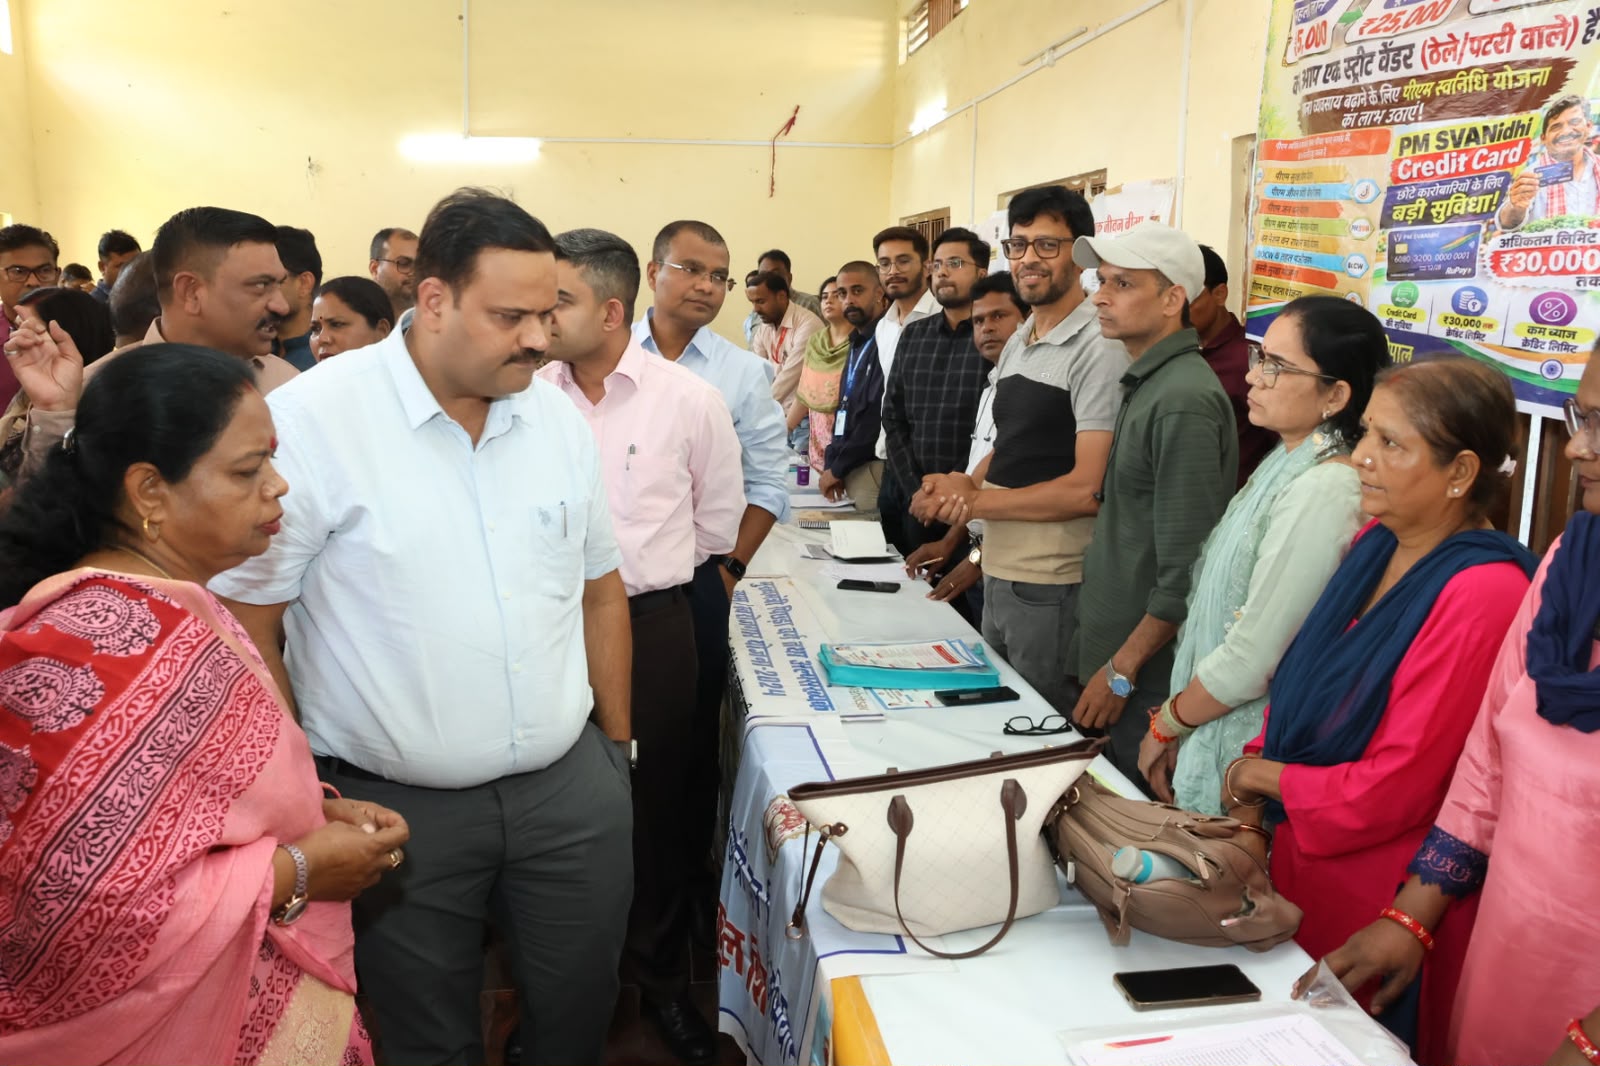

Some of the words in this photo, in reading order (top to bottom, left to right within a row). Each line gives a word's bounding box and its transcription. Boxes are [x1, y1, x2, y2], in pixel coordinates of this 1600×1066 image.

[1344, 46, 1376, 82] स्ट्रीट
[1520, 14, 1580, 51] वाले)
[1368, 86, 1378, 106] के
[1378, 83, 1401, 105] लिए
[1402, 79, 1434, 101] पीएम
[1435, 68, 1489, 97] स्वनिधि
[1493, 65, 1552, 91] योजना
[1341, 112, 1359, 129] का
[1357, 111, 1385, 127] लाभ
[1385, 101, 1424, 124] उठाएं!
[1399, 133, 1430, 156] PM
[1434, 117, 1534, 149] SVANidhi
[1397, 151, 1468, 181] Credit
[1471, 140, 1525, 170] Card
[1396, 186, 1416, 201] छोटे
[1417, 179, 1470, 198] कारोबारियों
[1471, 176, 1482, 190] के
[1483, 175, 1505, 190] लिए
[1391, 198, 1428, 225] बड़ी
[1430, 191, 1500, 222] सुविधा!
[1500, 234, 1553, 249] अधिकतम
[1556, 230, 1598, 244] लिमिट
[1500, 248, 1600, 274] ₹30,000
[1386, 308, 1401, 317] Credit
[1402, 310, 1417, 319] Card
[1443, 315, 1481, 329] ₹30,000
[1527, 325, 1547, 336] कम
[1549, 327, 1577, 340] ब्याज
[1548, 340, 1578, 354] लिमिट
